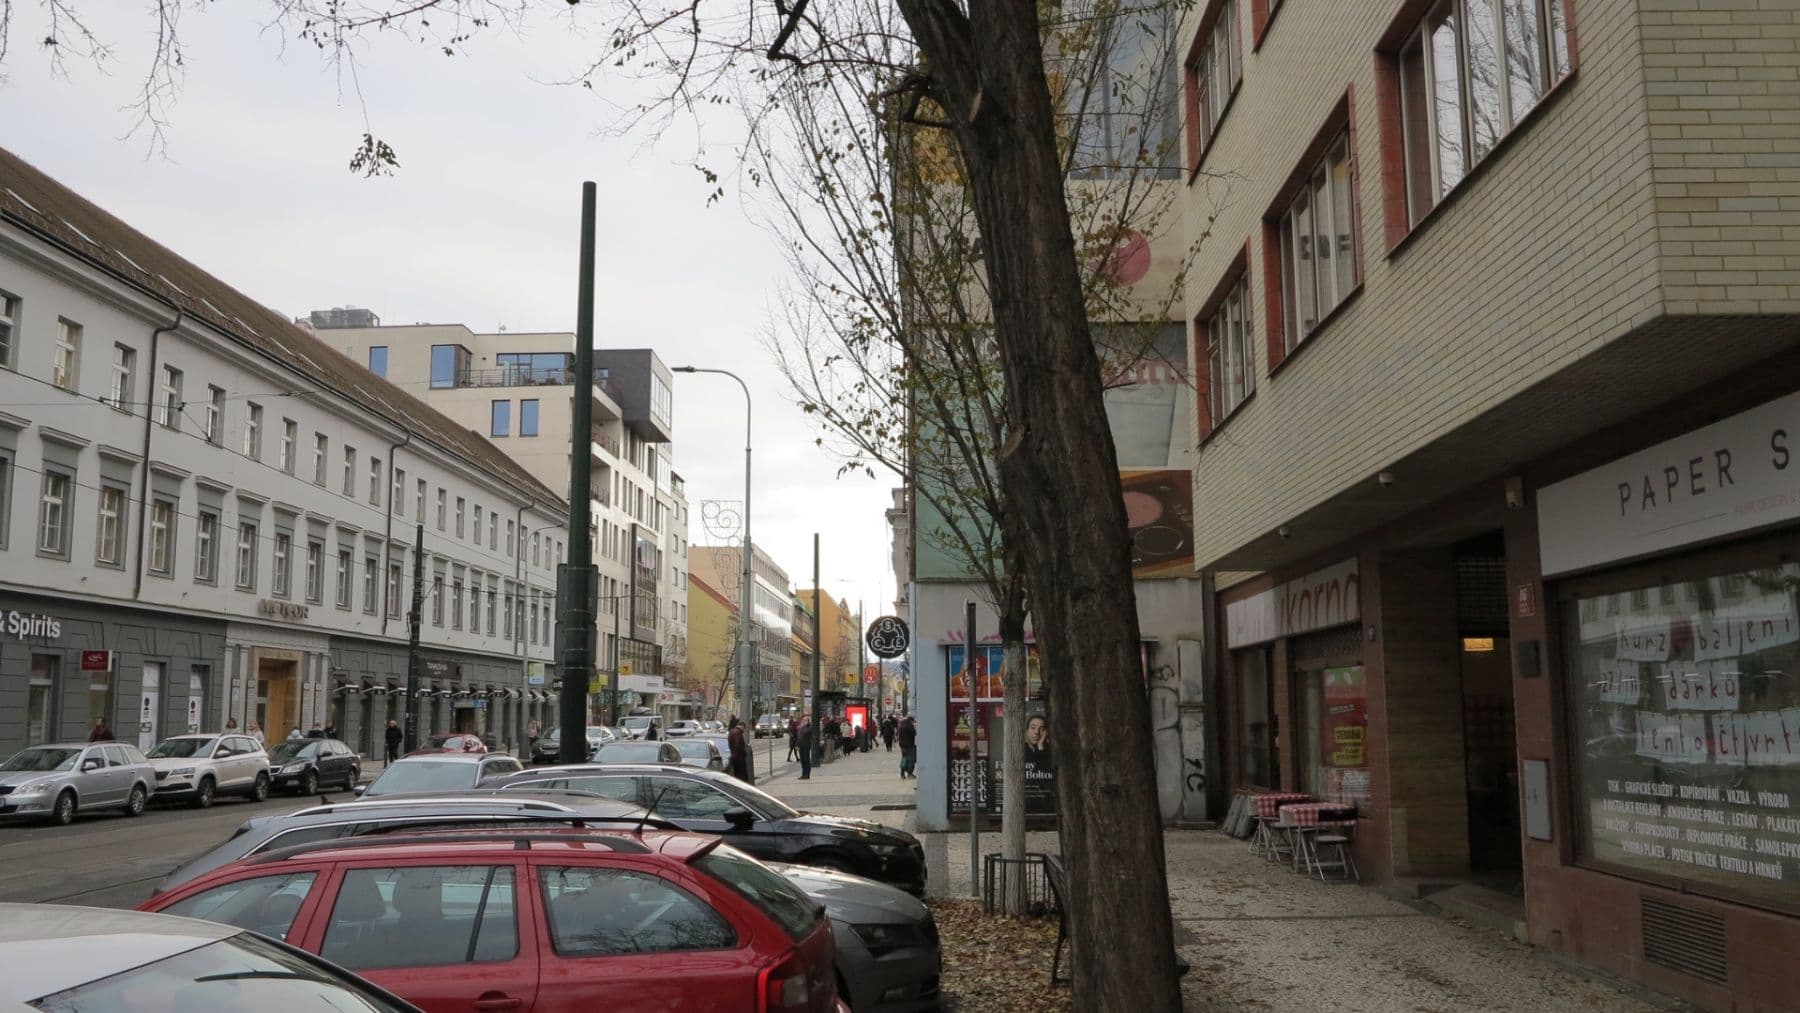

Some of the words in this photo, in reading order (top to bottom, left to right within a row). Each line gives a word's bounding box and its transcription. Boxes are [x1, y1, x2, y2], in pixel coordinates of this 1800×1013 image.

[1617, 448, 1734, 516] PAPER
[1771, 429, 1790, 470] S
[8, 610, 61, 640] Spirits
[1719, 717, 1800, 755] čtvrt
[1025, 770, 1053, 779] Bolto
[1726, 788, 1750, 805] VAZBA
[1758, 788, 1790, 808] VÝROBA
[1703, 807, 1725, 825] PRÁCE
[1732, 810, 1758, 829] LETÁKY
[1725, 831, 1747, 851] PRÁCE
[1720, 855, 1748, 874] TEXTILU
